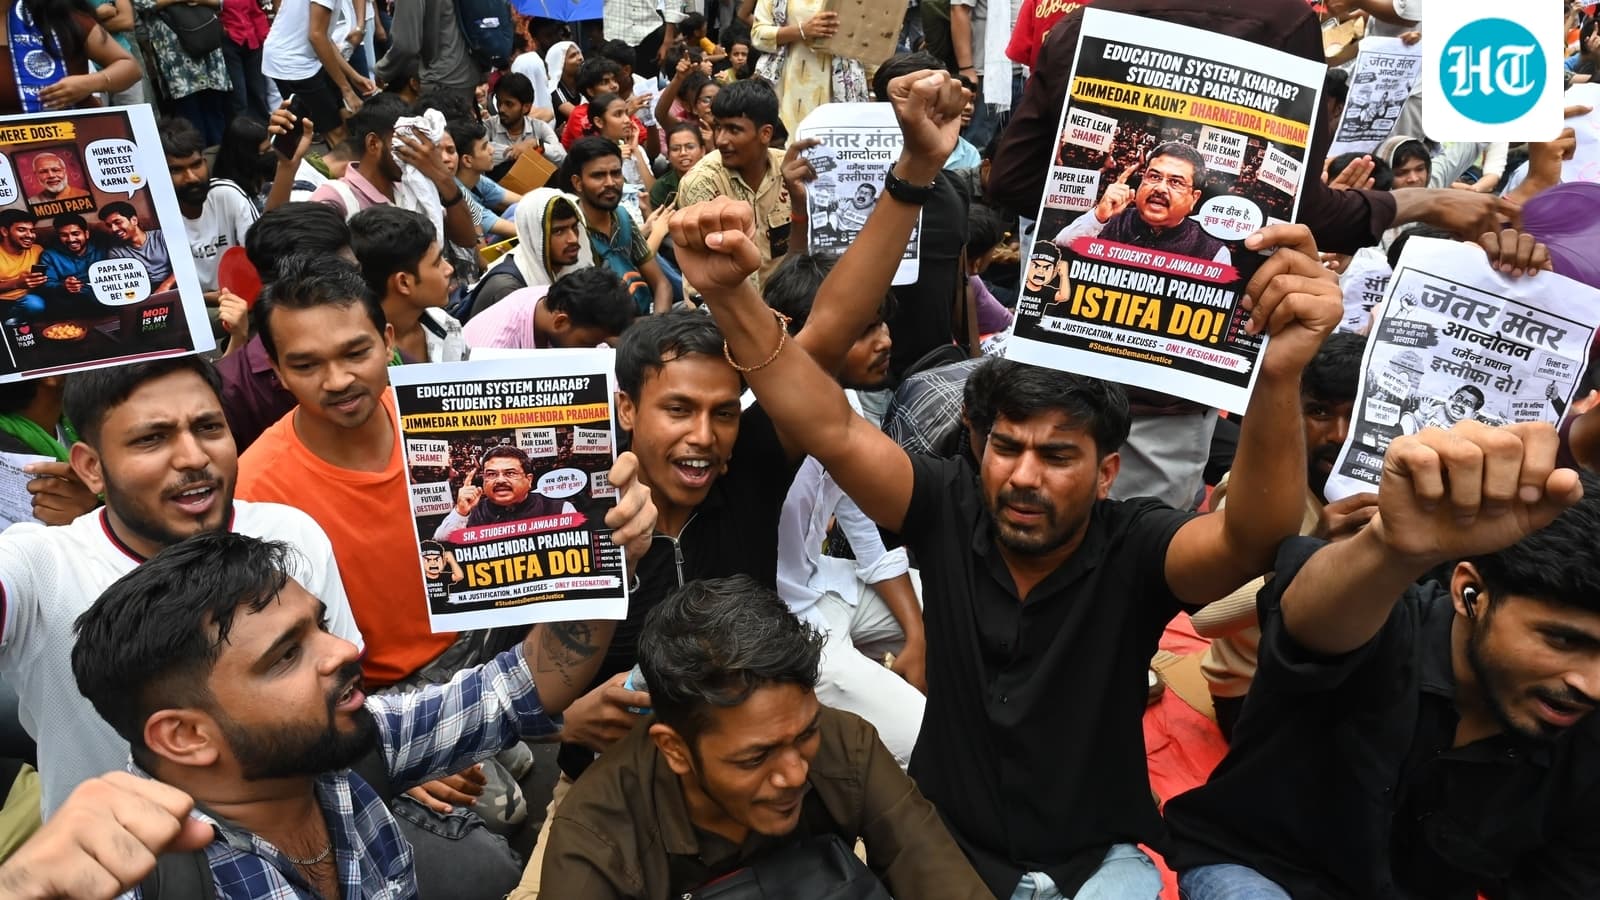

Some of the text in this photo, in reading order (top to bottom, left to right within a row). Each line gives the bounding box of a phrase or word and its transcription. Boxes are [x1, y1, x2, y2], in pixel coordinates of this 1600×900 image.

[1102, 43, 1300, 101] EDUCATION SYSTEM KHARAB?
[1126, 66, 1280, 113] STUDENTS PARESHAN?
[1074, 80, 1308, 145] JIMMEDAR KAUN? DHARMENDRA PRADHAN!
[1070, 114, 1113, 134] NEET LEAK
[30, 126, 64, 139] DOST:
[1071, 128, 1105, 145] SHAME!
[1208, 132, 1241, 147] WE WANT
[92, 145, 133, 156] HUME KYA
[836, 147, 892, 160] आन्दोलन
[1202, 142, 1241, 158] FAIR EXAMS
[98, 155, 133, 166] PROTEST
[1213, 156, 1239, 169] SCAMS!
[1269, 152, 1298, 172] EDUCATION
[101, 165, 135, 176] VROTEST
[837, 170, 875, 183] इस्तीफा
[1053, 171, 1095, 184] PAPER LEAK
[1275, 166, 1287, 176] NOT
[100, 176, 129, 187] KARNA
[1261, 169, 1294, 192] CORRUPTION!
[1059, 183, 1086, 195] FUTURE
[34, 198, 93, 216] MODI PAPA
[1049, 194, 1092, 207] DESTROYED!
[1212, 204, 1224, 214] सब
[1226, 205, 1242, 216] ठीक
[1204, 214, 1219, 227] कुछ
[1236, 222, 1255, 233] हुआ!
[97, 262, 134, 274] PAPA SAB
[1087, 243, 1222, 279] SIR, STUDENTS KO JAWAAB DO!
[94, 271, 145, 284] JAANTE HAIN,
[101, 280, 139, 292] CHILL KAR
[1070, 260, 1235, 310] DHARMENDRA PRADHAN
[110, 292, 122, 301] BE!
[142, 306, 169, 317] MODI
[1070, 284, 1225, 344] ISTIFA DO!
[1421, 284, 1500, 329] जंतर
[1501, 310, 1567, 351] मंतर
[142, 315, 168, 325] IS MY
[16, 333, 34, 341] MODI
[17, 339, 35, 348] PAPA
[1051, 320, 1240, 368] NA JUSTIFICATION, NA EXCUSES ONLY RESIGNATION!
[1442, 321, 1535, 361] आन्दोलन
[1088, 342, 1173, 366] #StudentsDemandJustice
[1430, 355, 1494, 387] इस्तीफा
[1483, 356, 1513, 374] प्रधान
[416, 377, 590, 399] EDUCATION SYSTEM KHARAB?
[442, 392, 574, 412] STUDENTS PARESHAN?
[405, 406, 608, 430] JIMMEDAR KAUN? DHARMENDRA PRADHAN!
[532, 431, 550, 439] WANT
[410, 444, 446, 453] NEET LEAK
[415, 454, 443, 462] SHAME!
[412, 485, 447, 496] PAPER LEAK
[420, 494, 443, 503] FUTURE
[416, 503, 451, 513] DESTROYED!
[463, 517, 573, 541] SIR, STUDENTS KO JAWAAB DO!
[455, 531, 589, 562] DHARMENDRA PRADHAN
[466, 548, 591, 587] ISTIFA DO!
[469, 589, 512, 601] JUSTIFICATION,
[513, 587, 522, 595] NA
[522, 584, 548, 595] EXCUSES
[554, 580, 570, 589] ONLY
[571, 578, 611, 588] RESIGNATION!
